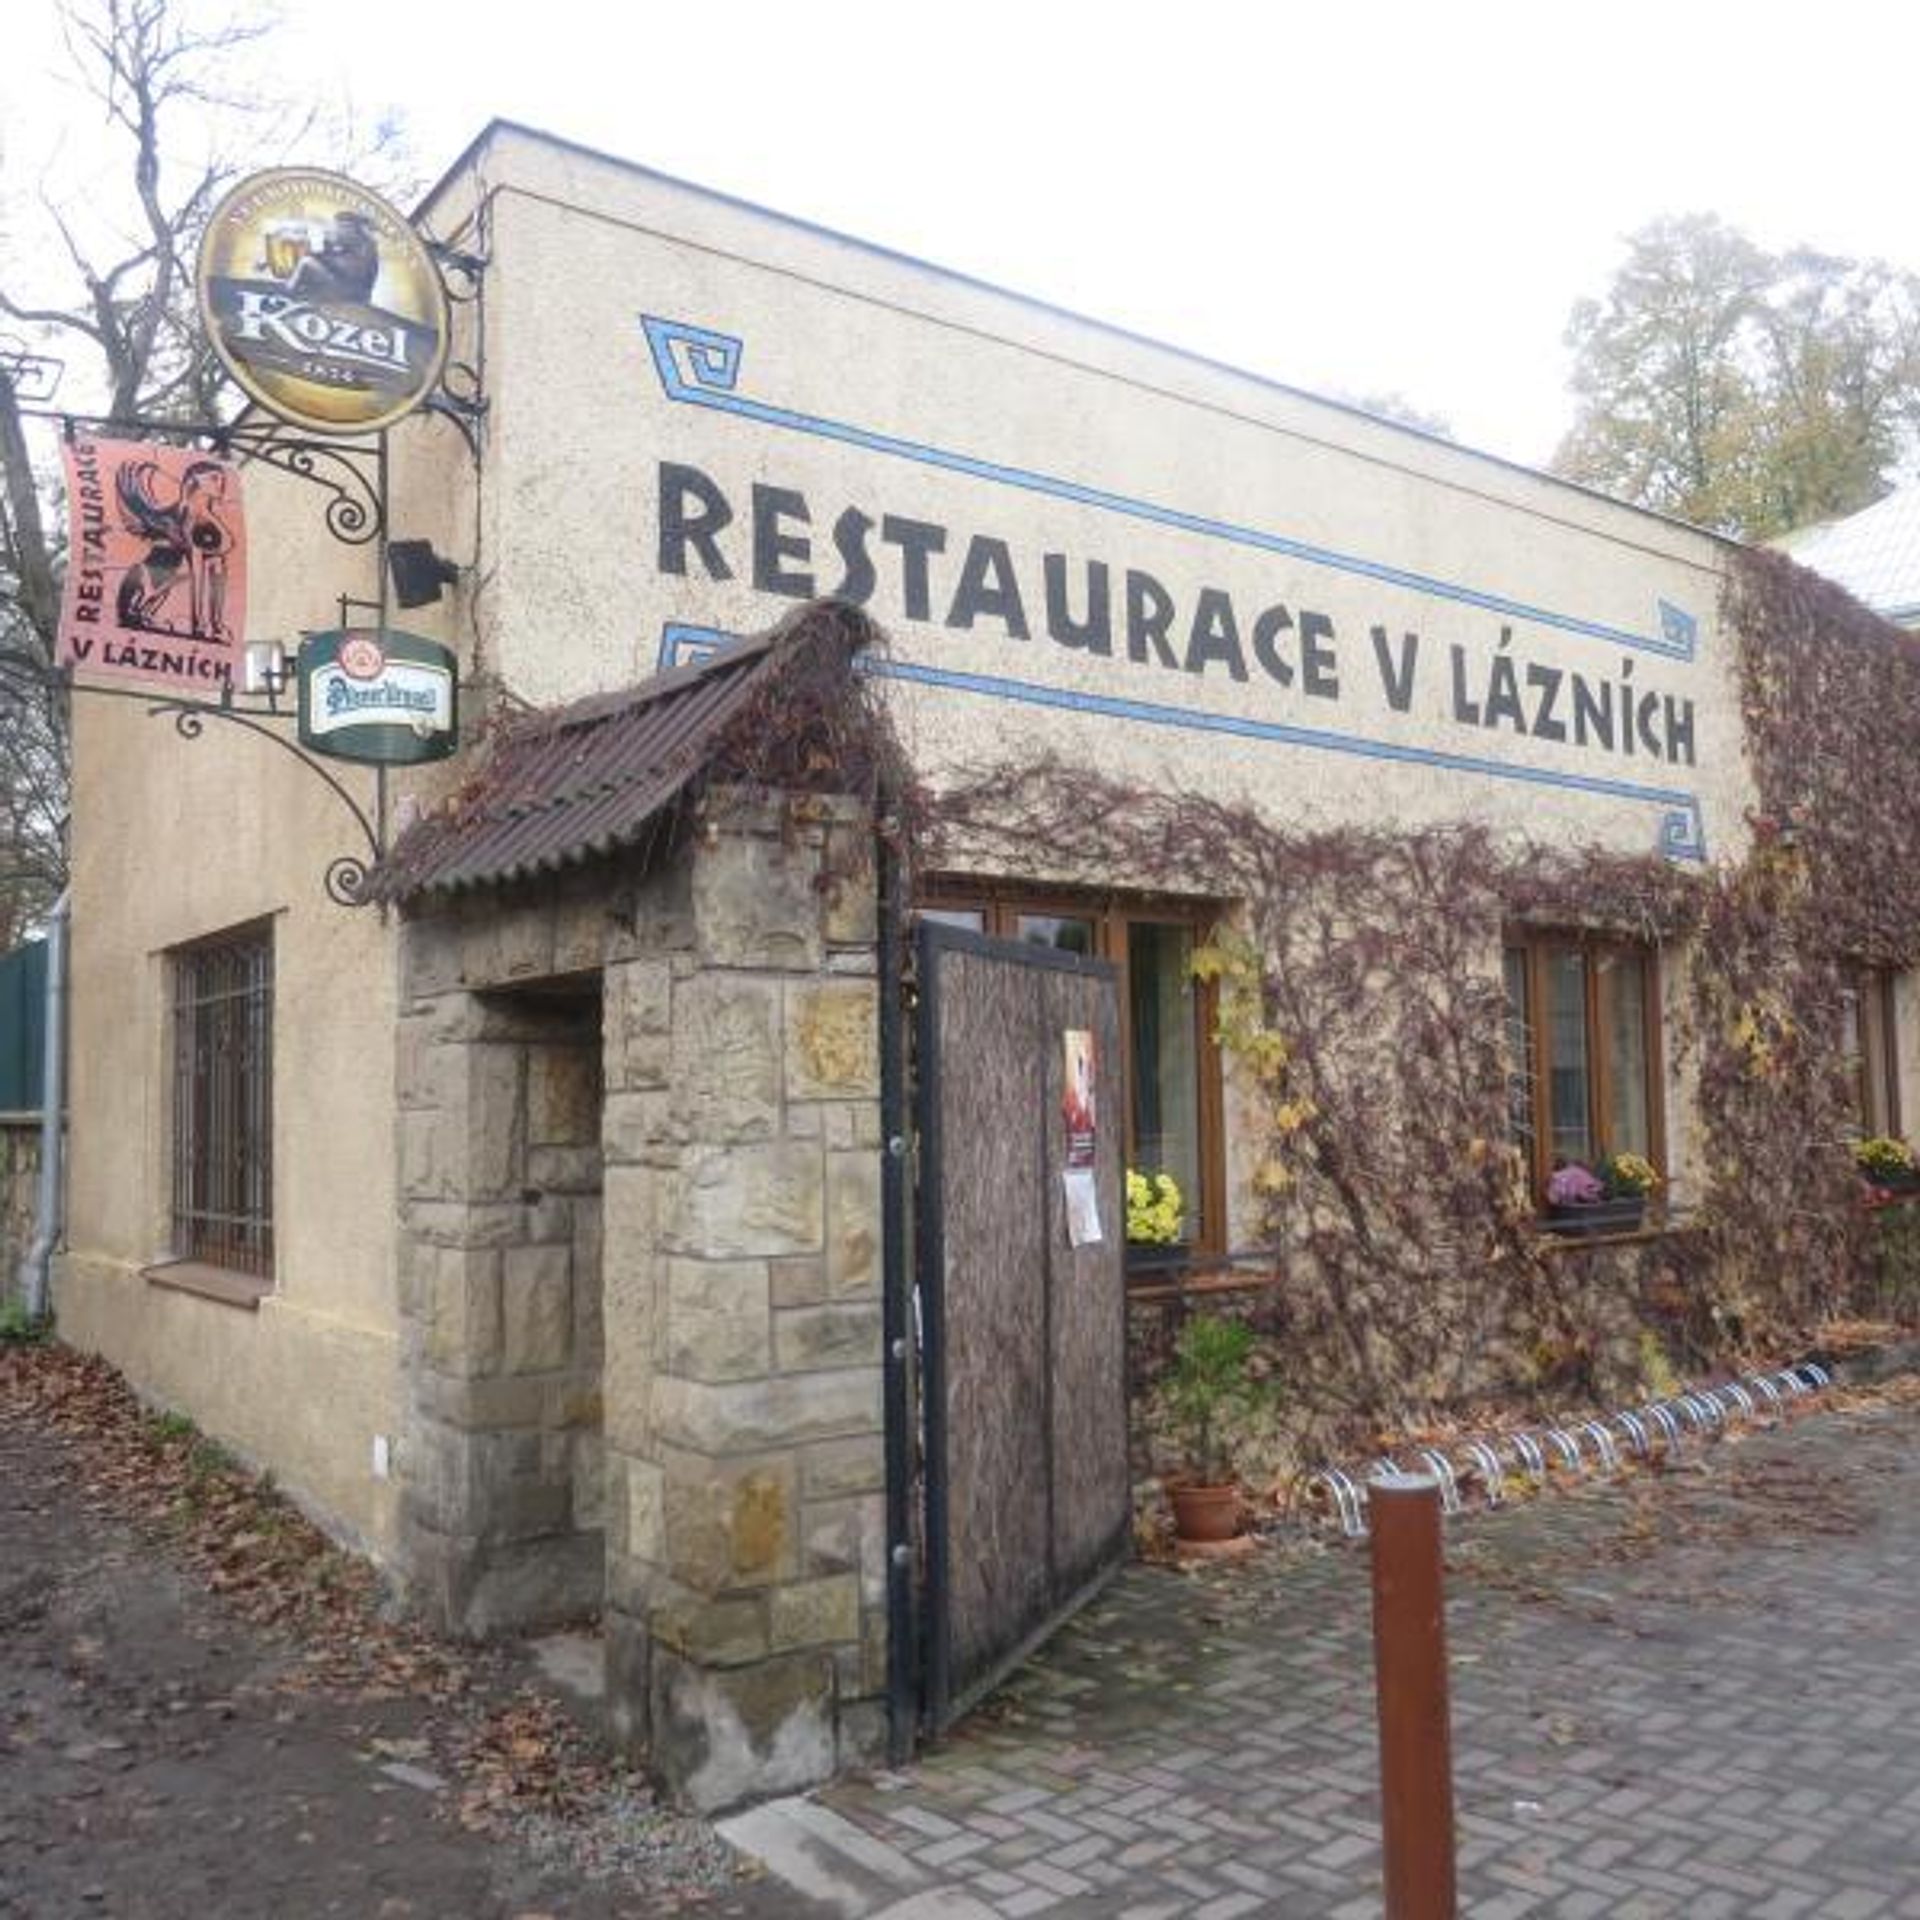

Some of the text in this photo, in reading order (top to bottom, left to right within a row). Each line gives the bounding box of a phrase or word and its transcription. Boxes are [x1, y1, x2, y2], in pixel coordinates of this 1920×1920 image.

[235, 290, 411, 372] Kozel
[658, 461, 1696, 767] RESTAURACE V LÁZNÍCH
[71, 636, 232, 680] V LÁZNÍCH
